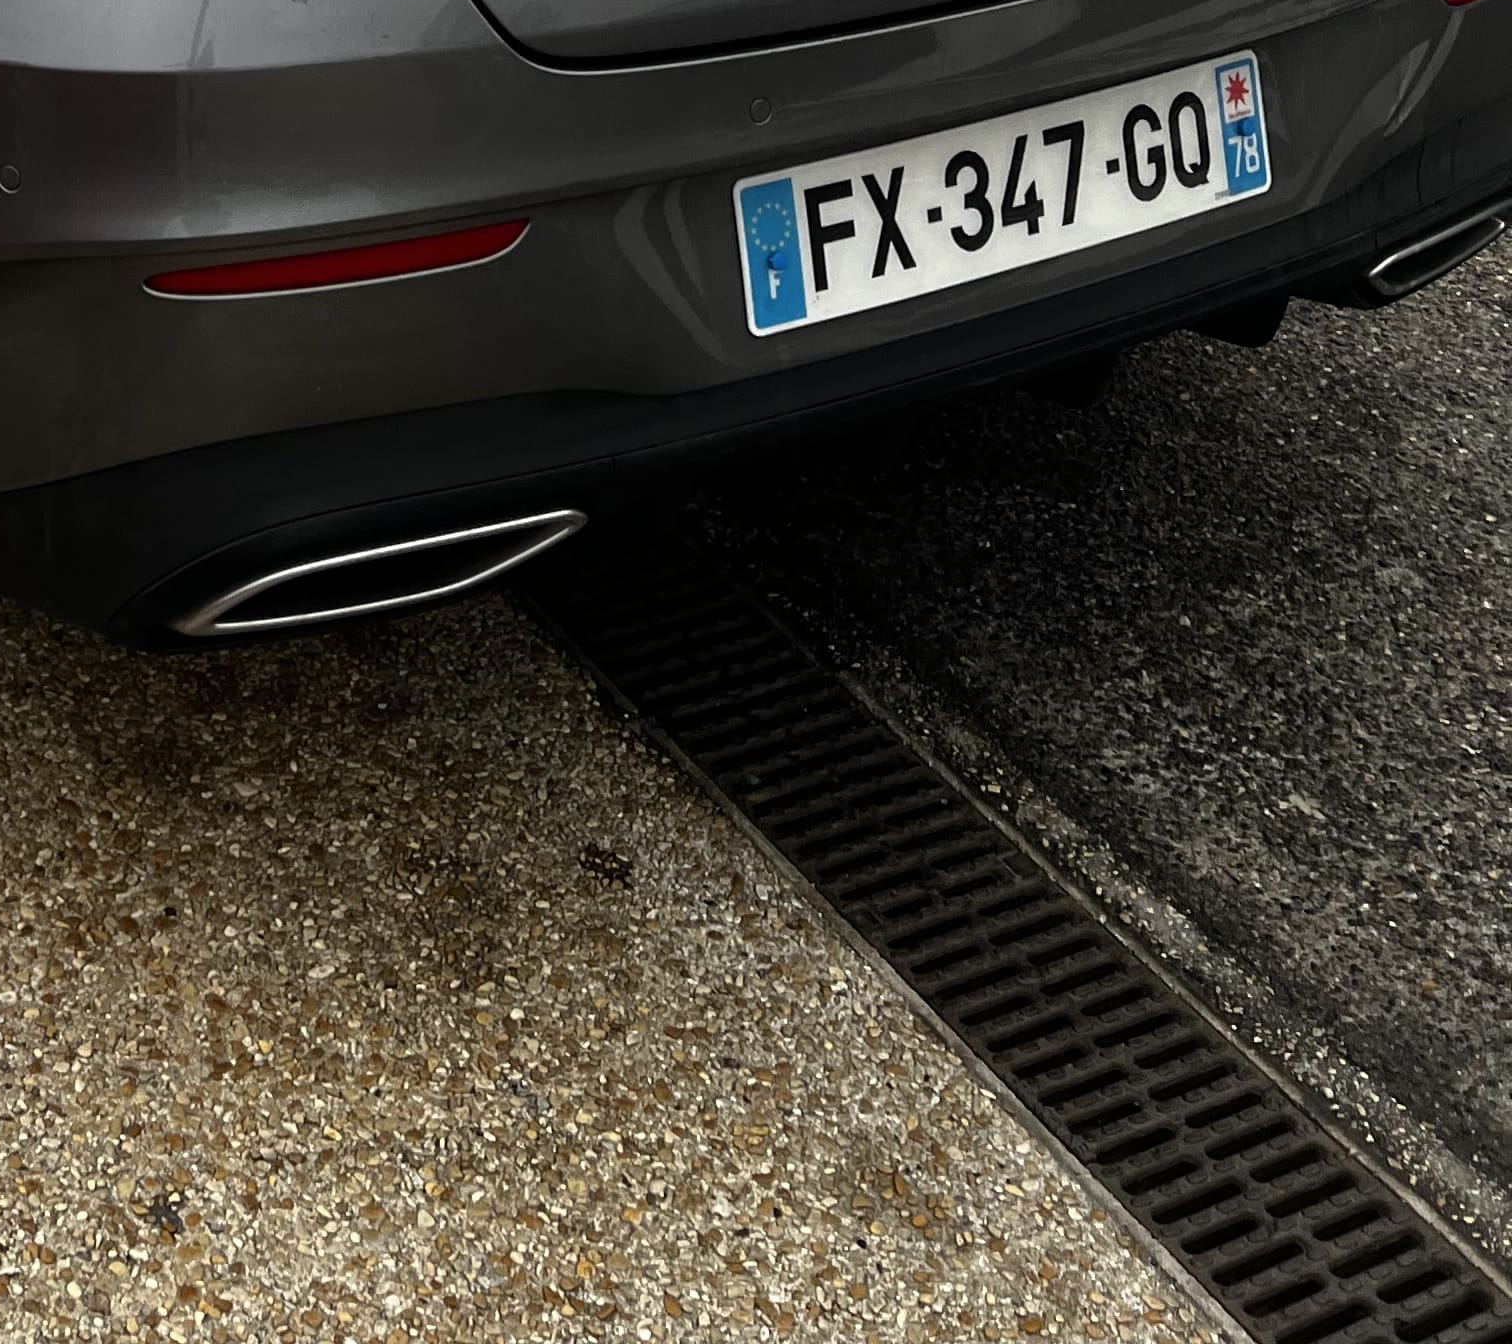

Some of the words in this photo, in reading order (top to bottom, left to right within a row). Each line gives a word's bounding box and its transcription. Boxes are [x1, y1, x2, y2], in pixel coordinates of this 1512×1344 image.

[1227, 131, 1261, 179] 78
[803, 91, 1211, 293] FX-347-GQ
[768, 269, 785, 300] F
